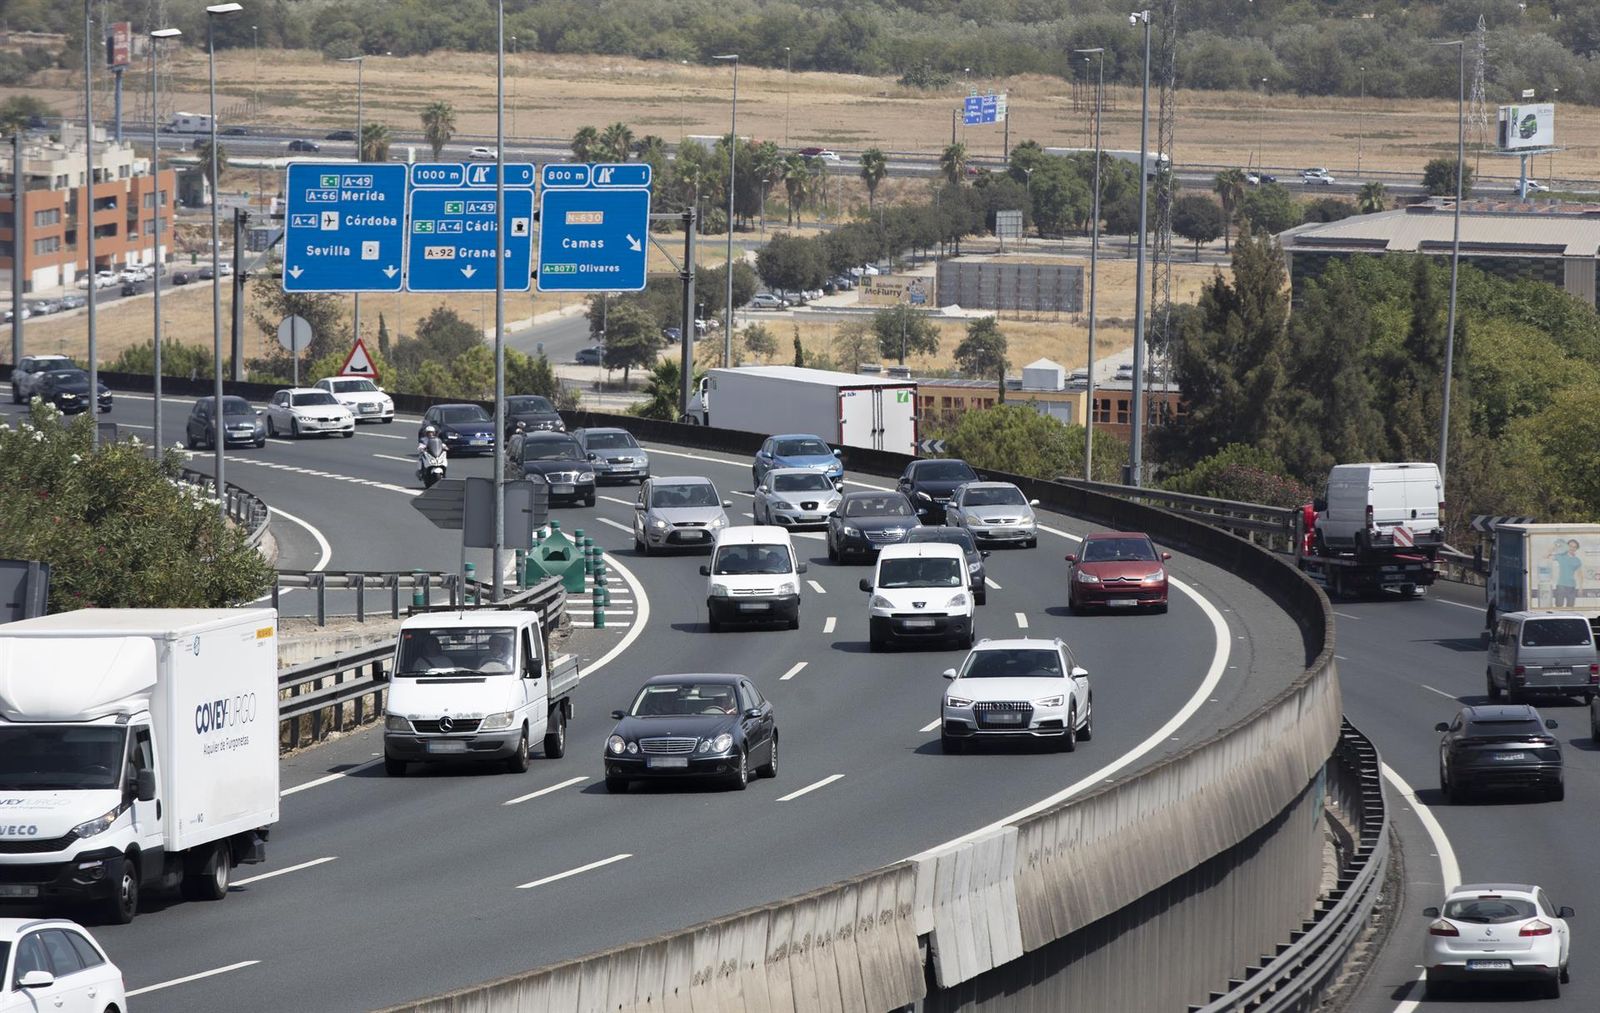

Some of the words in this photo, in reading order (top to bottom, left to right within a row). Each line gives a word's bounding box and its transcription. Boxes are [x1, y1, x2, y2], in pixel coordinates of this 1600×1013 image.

[417, 170, 445, 180] 1000
[522, 170, 529, 179] 0
[548, 171, 571, 180] 800
[322, 177, 339, 186] E-1
[344, 177, 371, 186] A-49
[308, 192, 336, 200] A-66
[341, 191, 385, 201] Merida
[446, 203, 462, 212] E-1
[468, 203, 495, 212] A-49
[294, 216, 315, 225] A-4
[345, 214, 397, 226] Córdoba
[567, 214, 602, 222] N-630
[415, 222, 433, 231] E-5
[439, 222, 461, 231] A-4
[562, 238, 604, 249] Camas
[306, 245, 351, 256] Sevilla
[426, 248, 454, 257] A-92
[459, 247, 512, 258] Granaa
[543, 264, 576, 272] A-8077
[579, 264, 620, 273] Olivares
